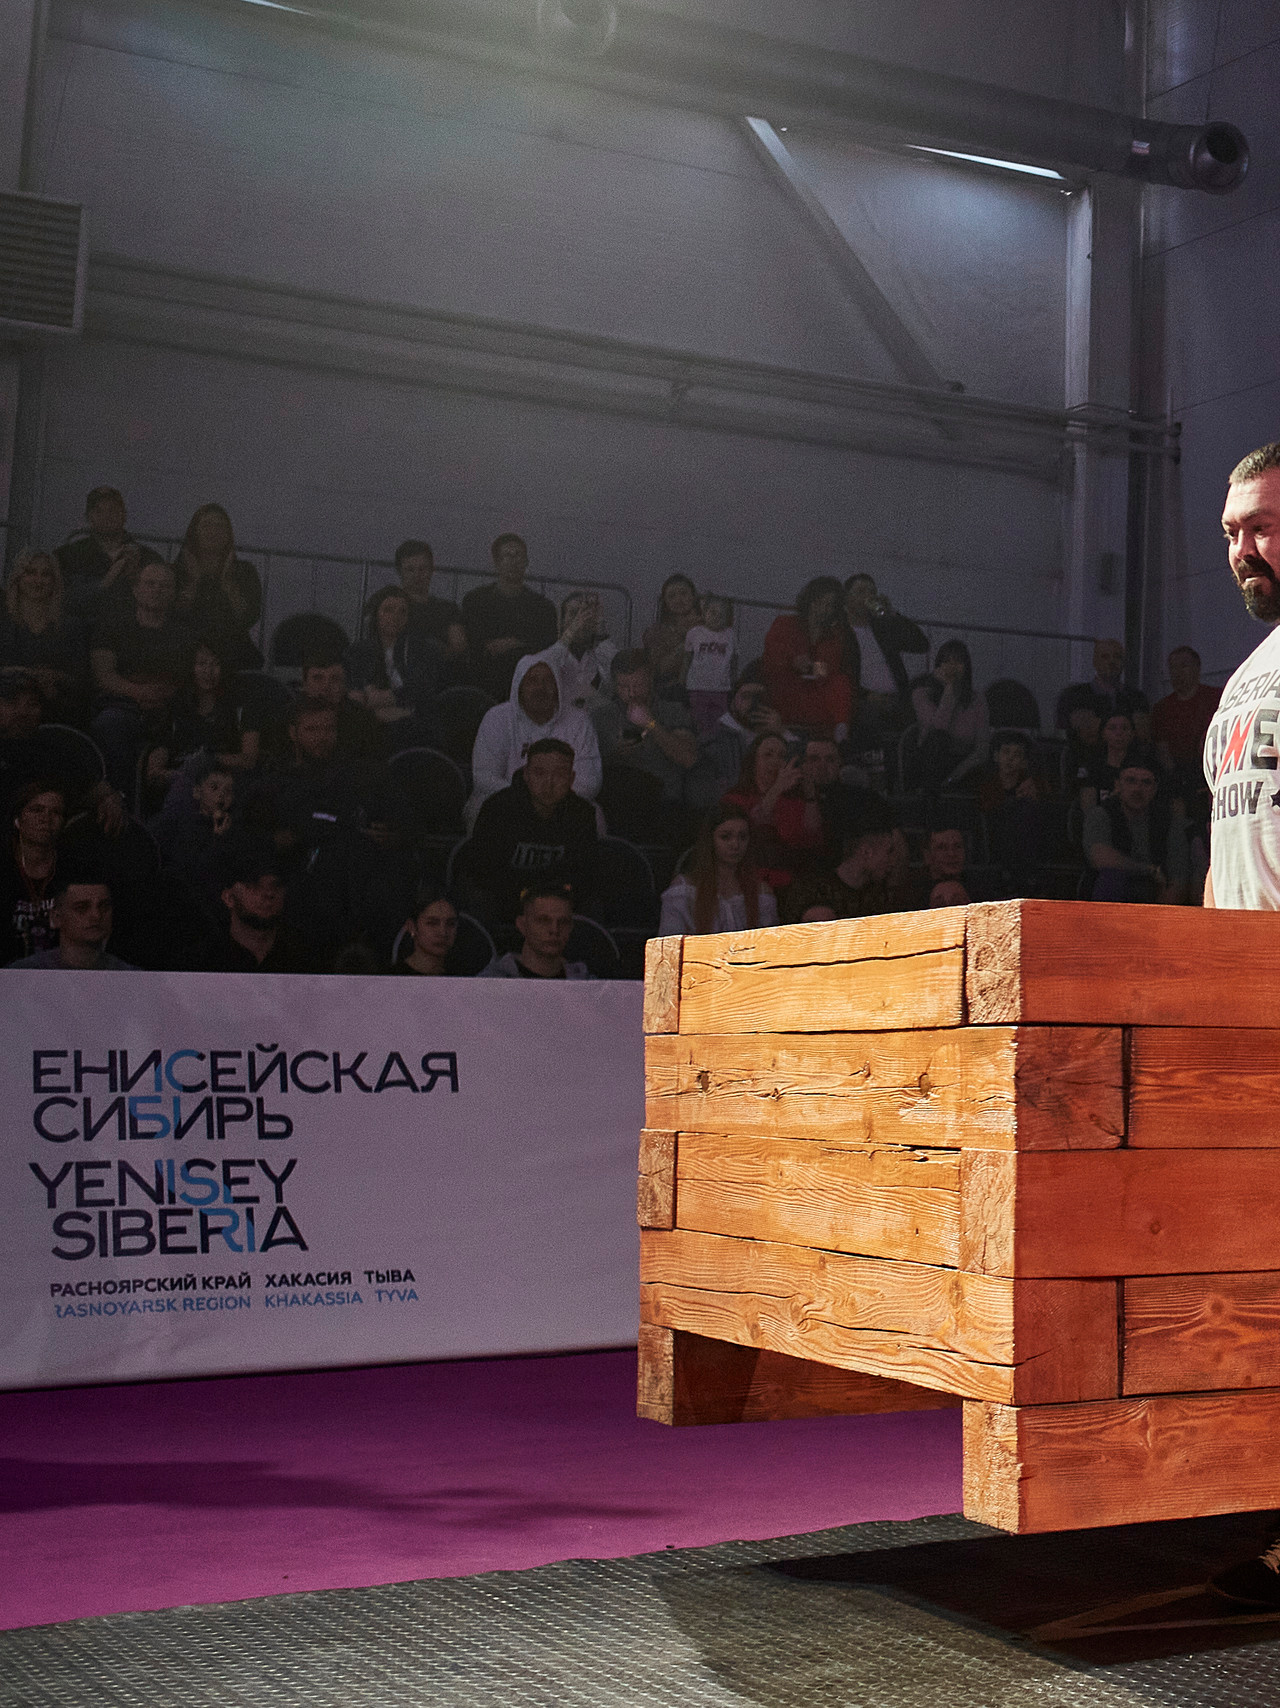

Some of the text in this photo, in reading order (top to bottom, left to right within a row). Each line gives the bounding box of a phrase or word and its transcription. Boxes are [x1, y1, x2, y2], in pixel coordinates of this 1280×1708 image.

[1212, 781, 1264, 822] HOW
[32, 1043, 460, 1094] ЕНИСЕЙСКАЯ
[32, 1096, 294, 1142] СИБИРЬ
[29, 1158, 298, 1209] YENISEY
[51, 1206, 309, 1260] SIBERIA
[182, 1294, 252, 1312] REGION
[264, 1290, 364, 1309] KHAKASSIA
[374, 1288, 420, 1303] TYVA
[202, 1271, 252, 1290] КРАЙ
[264, 1270, 353, 1289] ХАКАСИЯ
[363, 1268, 416, 1285] ТЫВА
